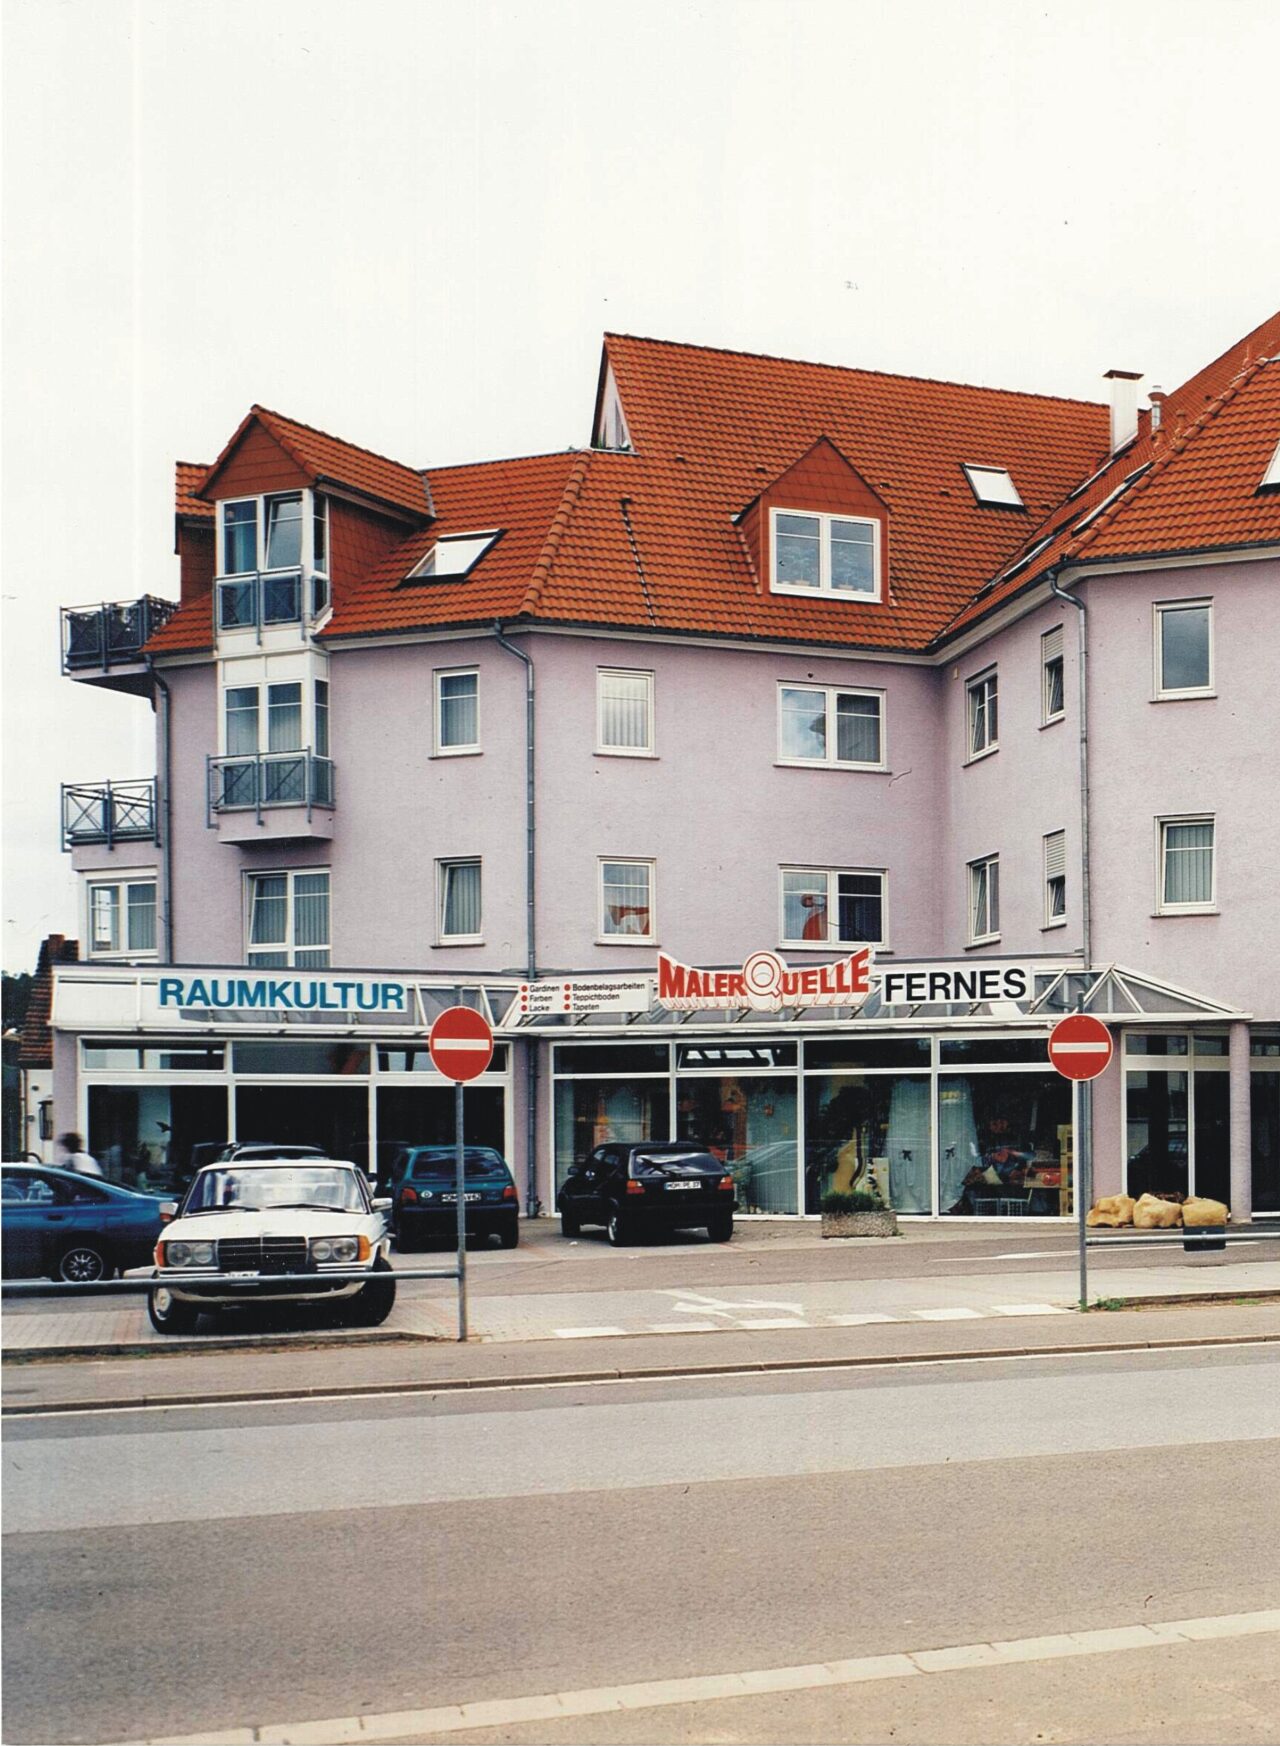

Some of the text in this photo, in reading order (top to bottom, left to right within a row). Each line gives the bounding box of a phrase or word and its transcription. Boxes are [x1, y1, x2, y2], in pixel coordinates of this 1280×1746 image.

[659, 949, 870, 1000] MALERQUELLE
[529, 985, 560, 993] Gardinen
[573, 983, 646, 992] Bodenbelagsarbeiten
[884, 968, 1027, 1002] FERNES
[159, 978, 404, 1010] RAUMKULTUR
[573, 993, 620, 1001] Teppichboden
[573, 1003, 600, 1011] Tapeten
